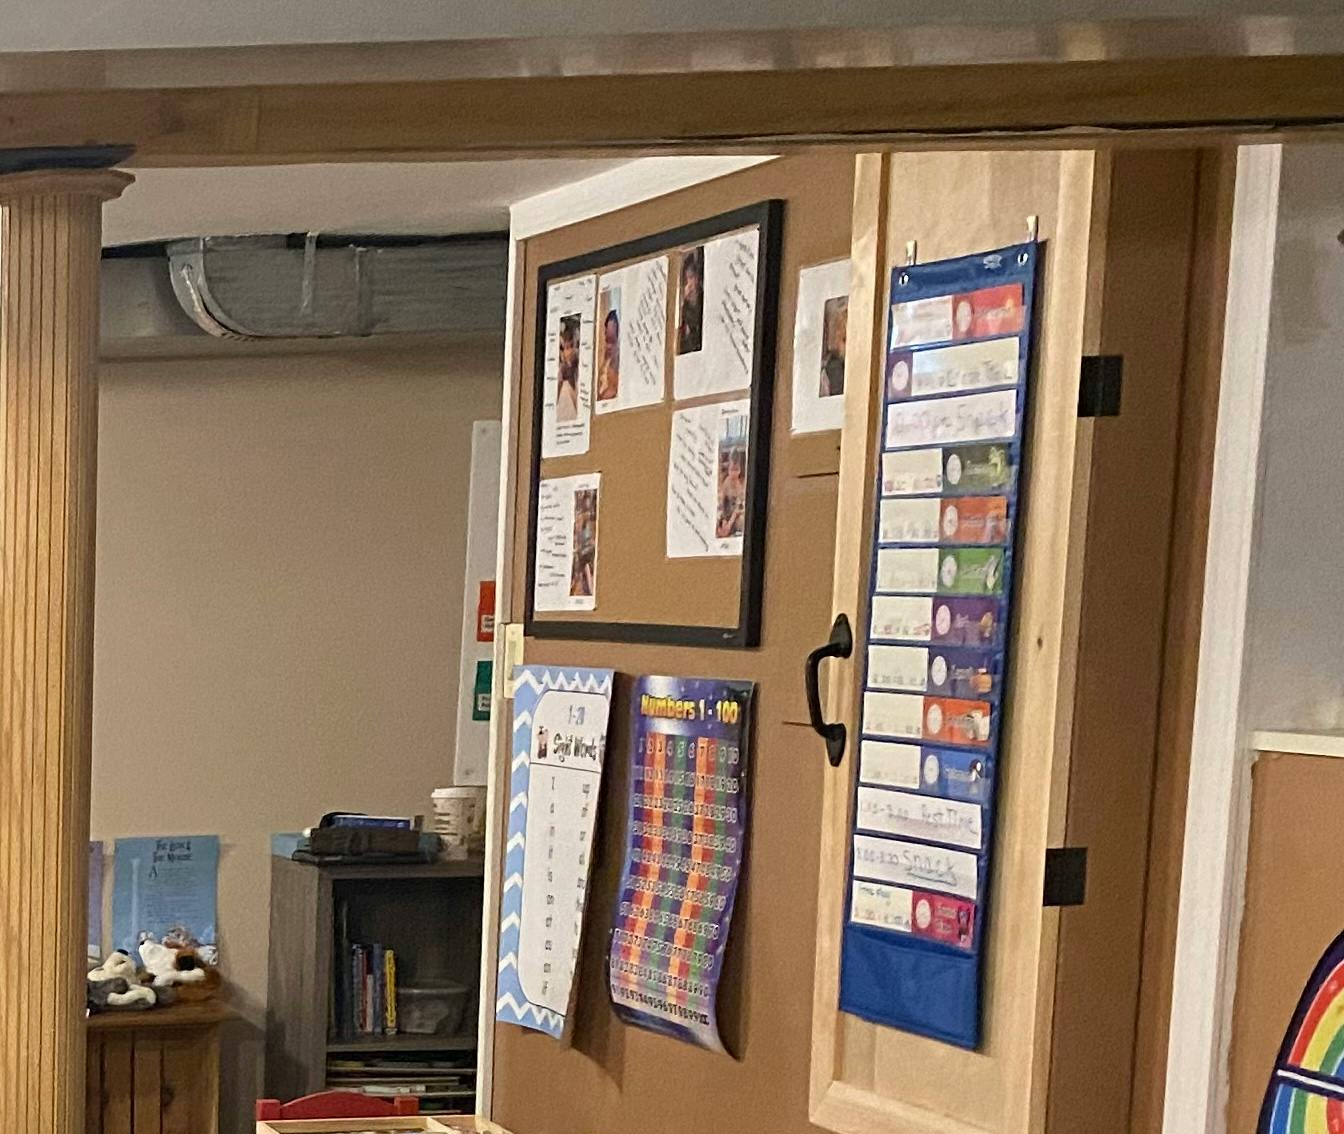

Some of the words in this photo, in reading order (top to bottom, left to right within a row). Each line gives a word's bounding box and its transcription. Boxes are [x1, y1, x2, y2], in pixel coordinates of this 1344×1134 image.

[640, 694, 696, 720] Numbers
[698, 699, 705, 721] 1
[716, 699, 739, 725] 100
